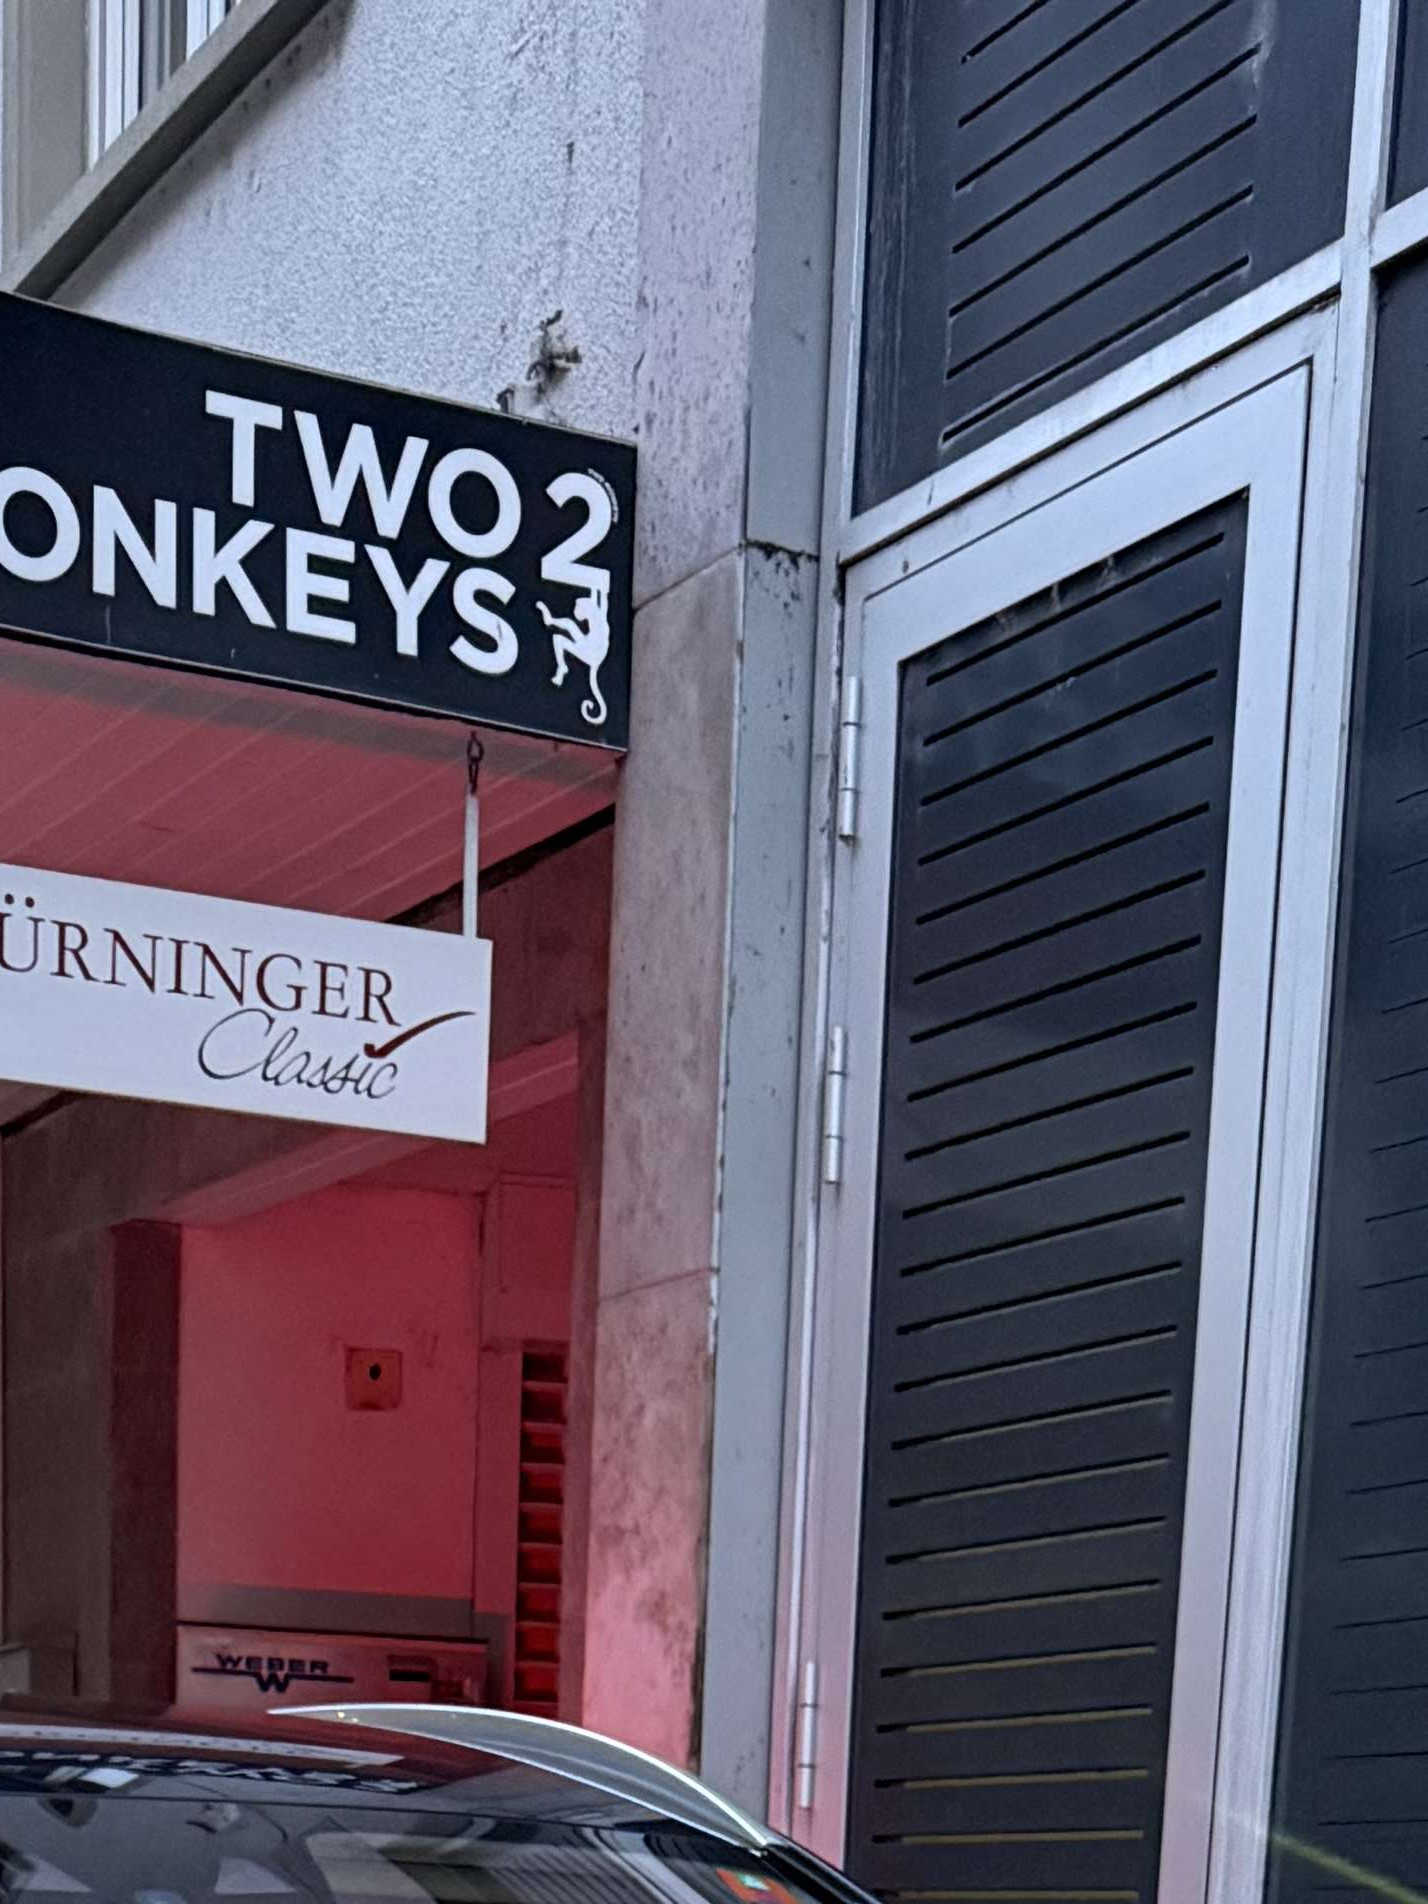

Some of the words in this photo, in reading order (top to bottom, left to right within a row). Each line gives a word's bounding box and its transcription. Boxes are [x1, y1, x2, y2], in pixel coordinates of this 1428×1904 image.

[204, 389, 522, 557] TWO
[197, 1007, 398, 1100] Classic
[216, 1653, 329, 1675] WEBER
